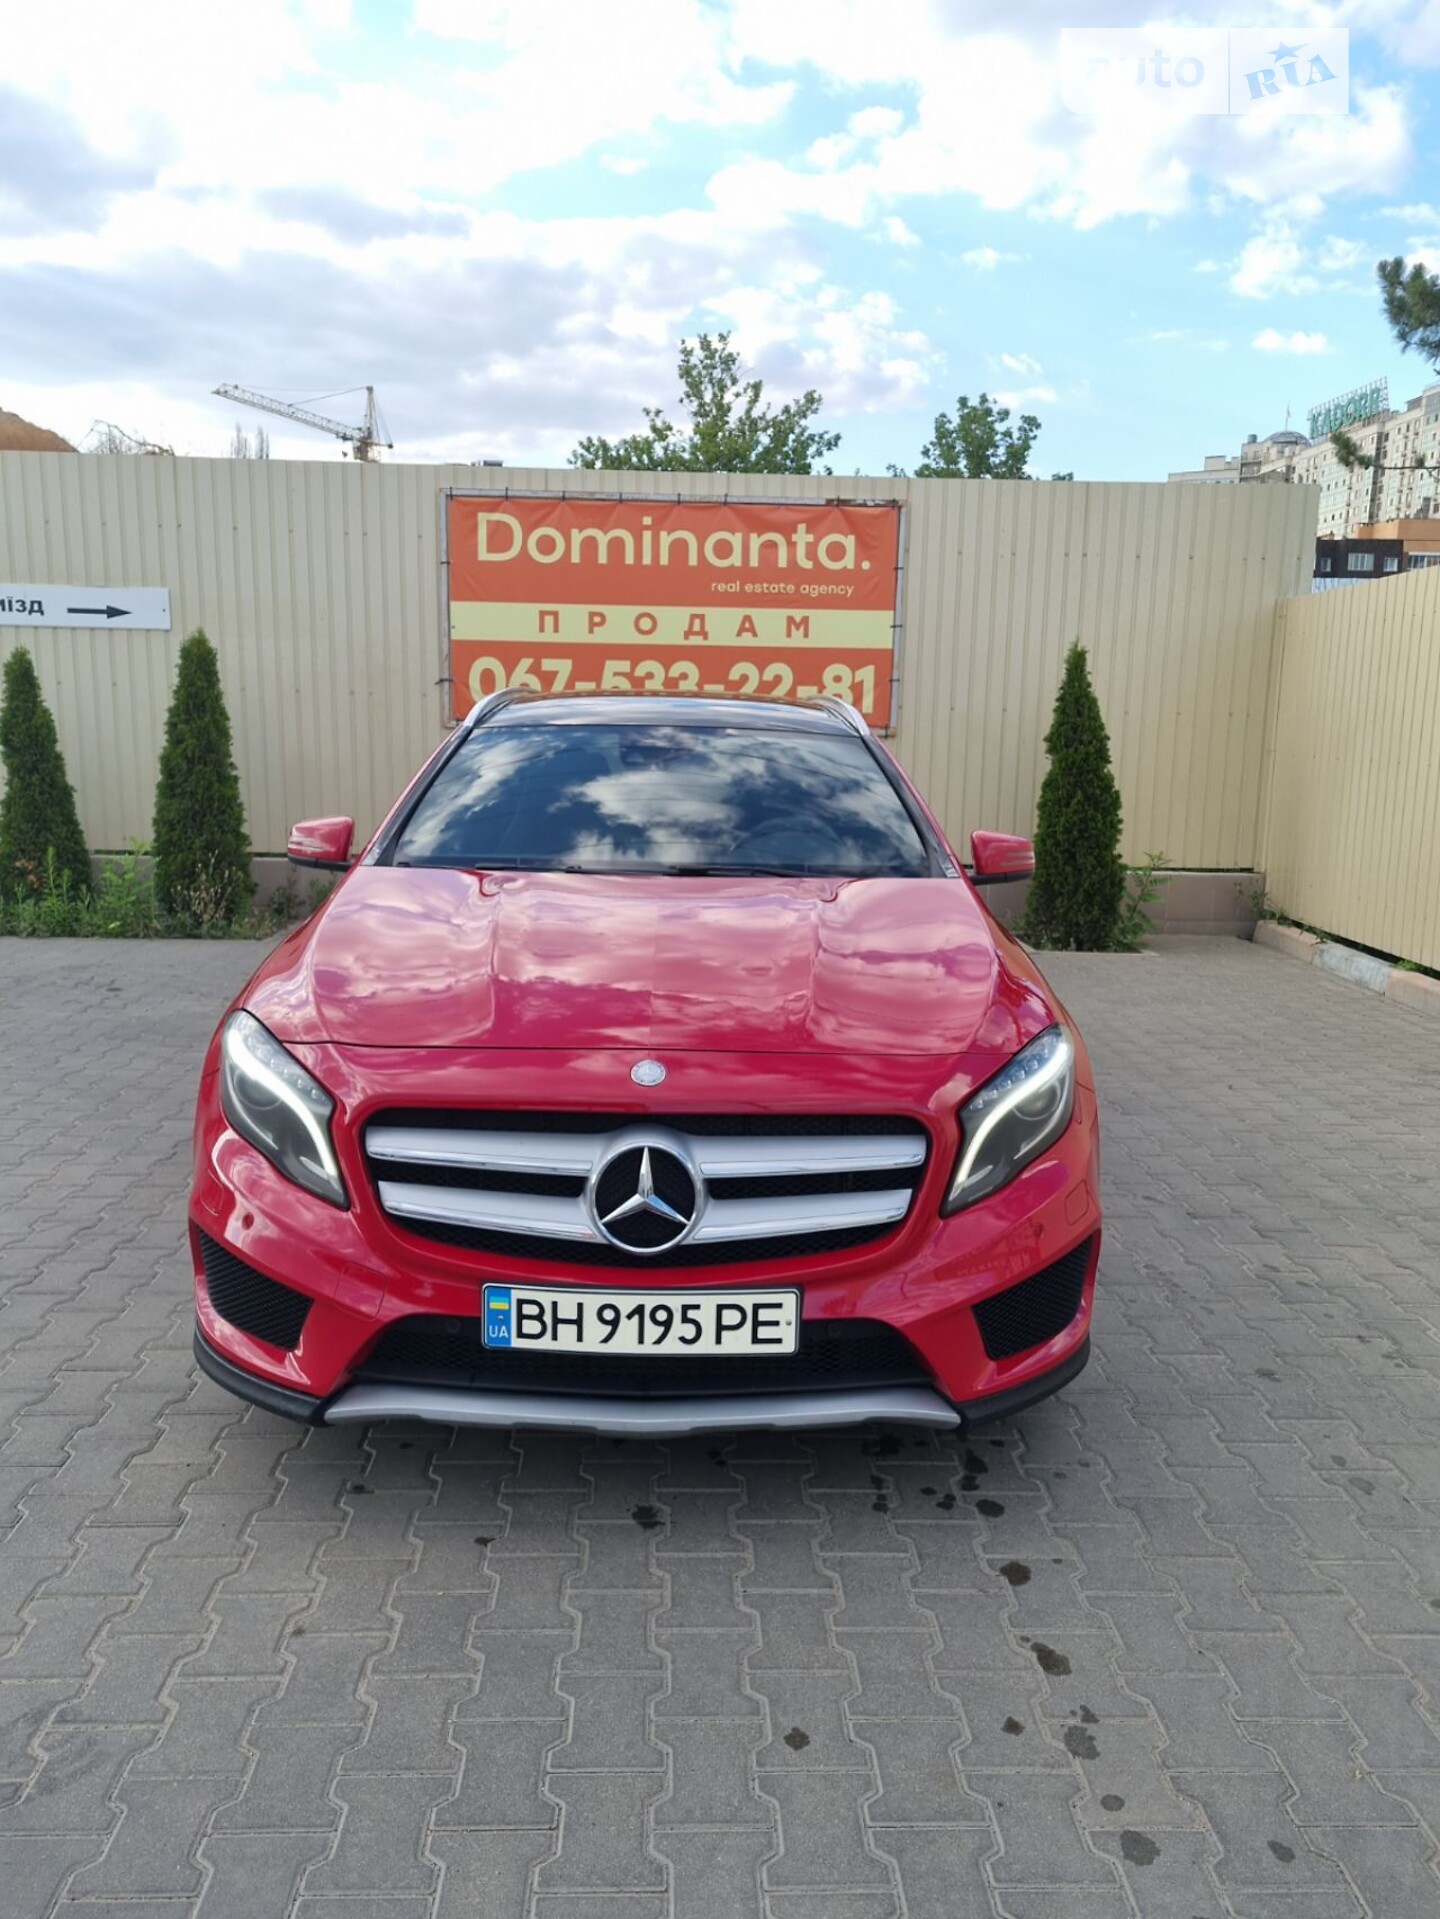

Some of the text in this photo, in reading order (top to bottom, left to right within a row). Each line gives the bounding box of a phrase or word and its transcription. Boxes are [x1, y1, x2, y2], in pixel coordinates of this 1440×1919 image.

[476, 512, 872, 571] Dominanta.
[711, 580, 855, 597] real estate agency
[538, 609, 811, 640] ПРОДАМ
[468, 655, 876, 714] 067-533-22-81
[488, 1325, 509, 1339] UA
[516, 1298, 783, 1345] BH 9195 PE
